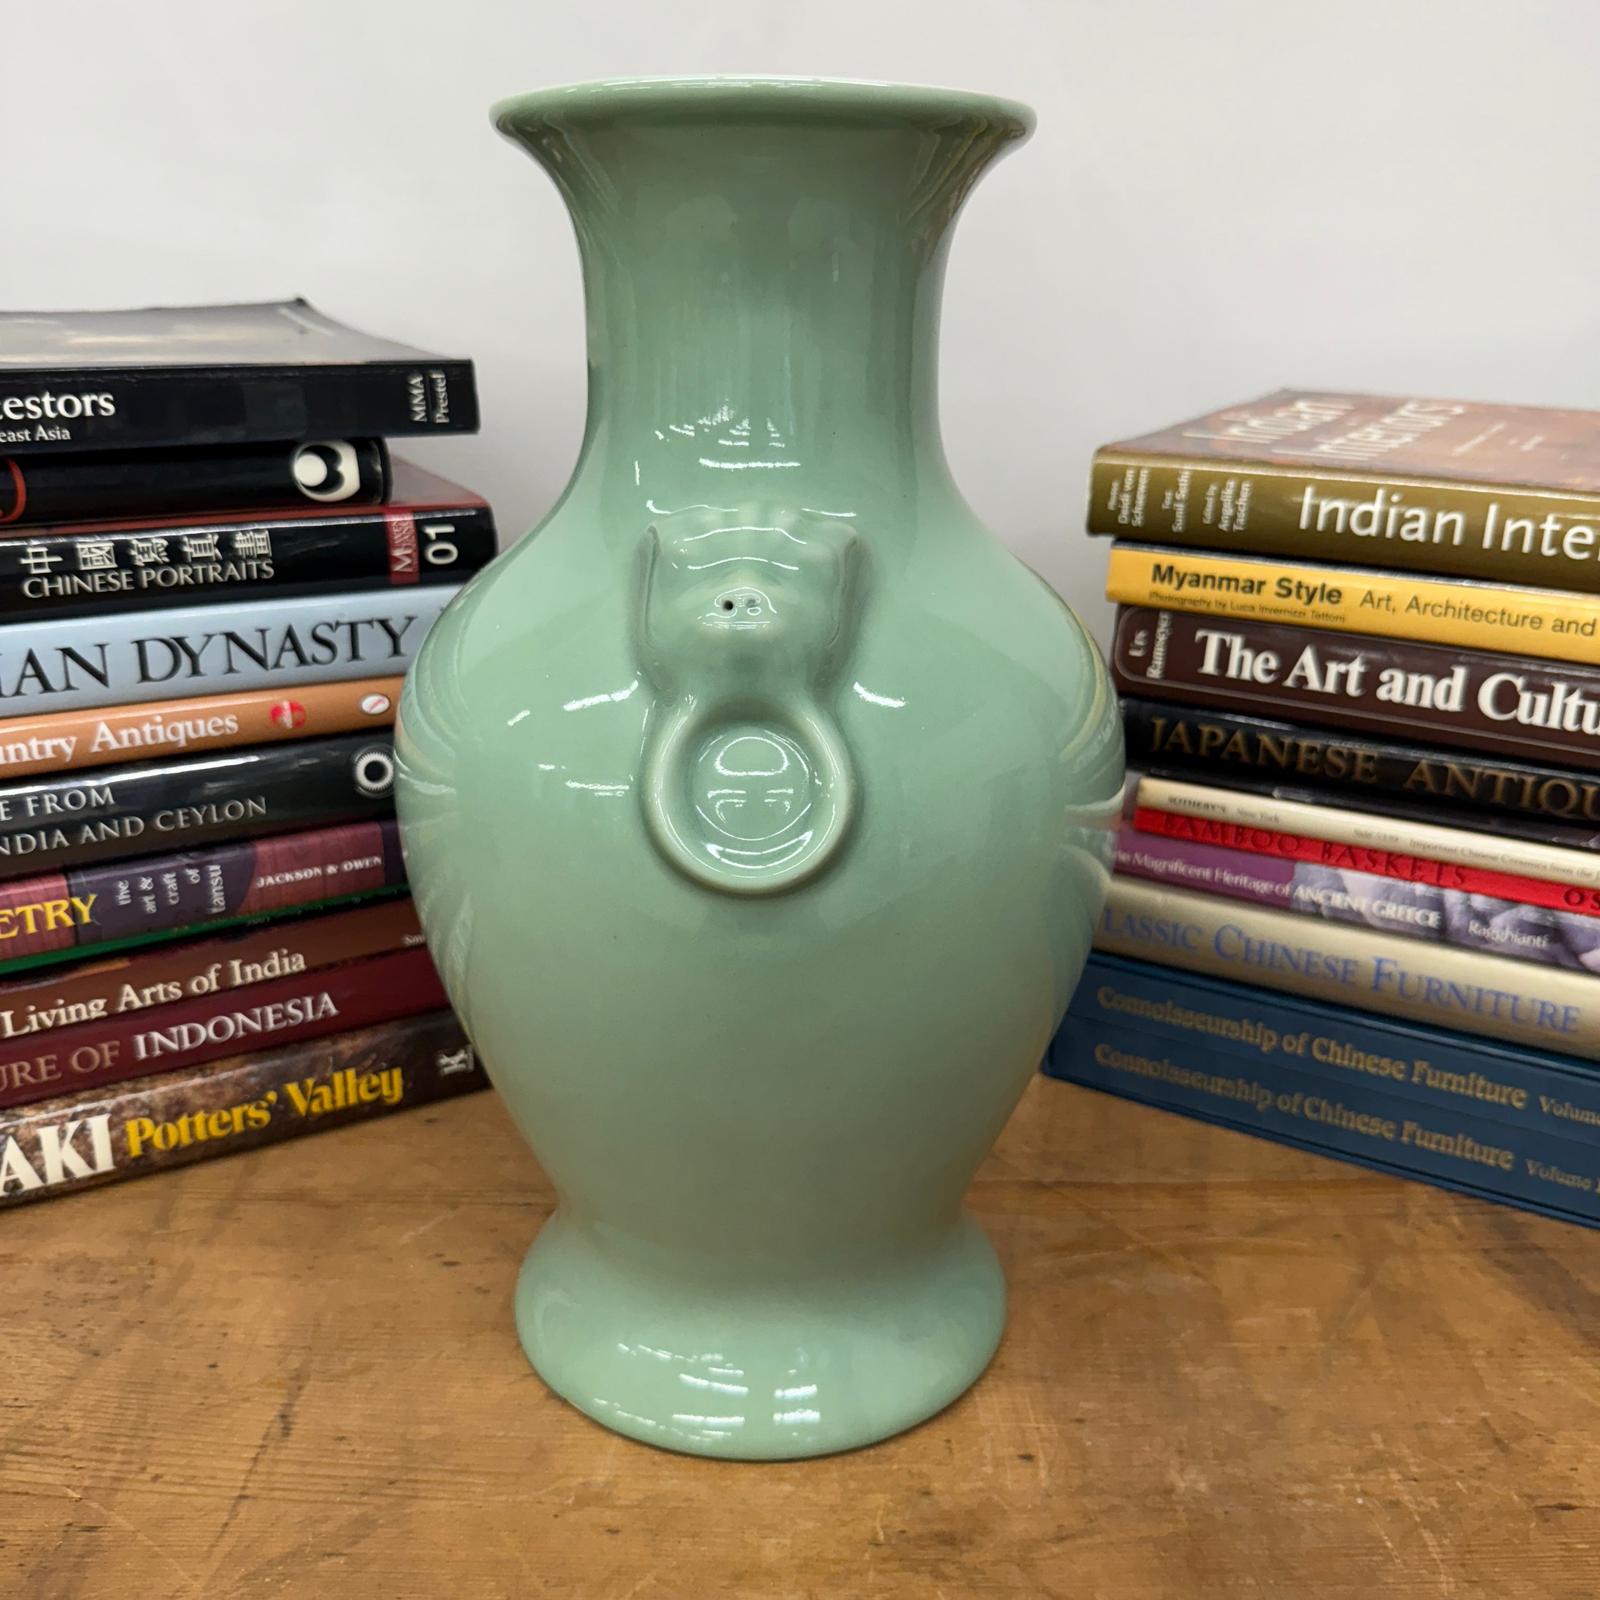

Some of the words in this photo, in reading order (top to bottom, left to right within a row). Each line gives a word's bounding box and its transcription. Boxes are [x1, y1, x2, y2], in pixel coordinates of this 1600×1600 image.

[0, 391, 116, 420] estors
[408, 372, 428, 422] MMA
[429, 369, 449, 424] Prestel
[35, 424, 71, 442] Asia
[1217, 479, 1236, 532] Angelika
[1233, 480, 1251, 532] Taschen
[1299, 484, 1465, 546] Indian
[1482, 502, 1600, 562] Inte
[424, 524, 458, 565] 01
[22, 569, 135, 598] CHINESE
[139, 558, 275, 589] PORTRAITS
[1151, 563, 1265, 596] Myanmar
[1275, 576, 1342, 607] Style
[1360, 589, 1396, 614] Art,
[1405, 594, 1543, 630] Architecture
[1551, 617, 1597, 637] and
[0, 642, 110, 698] AN
[131, 615, 418, 684] DYNASTY
[1194, 627, 1281, 684] The
[1282, 644, 1367, 695] Art
[1376, 664, 1469, 713] and
[91, 713, 239, 753] Antiques
[1151, 716, 1379, 783] JAPANESE
[26, 787, 116, 818] FROM
[80, 815, 145, 845] AND
[155, 796, 267, 832] CEYLON
[185, 867, 200, 885] of
[256, 866, 323, 889] JACKSON
[326, 863, 338, 876] &
[342, 855, 383, 874] OWEN
[1163, 814, 1301, 854] BAMBOO
[1320, 840, 1467, 885] BASKETS
[1132, 852, 1212, 882] Magnificent
[1214, 867, 1274, 895] Heritage
[1274, 881, 1292, 897] of
[1371, 900, 1441, 929] GREECE
[0, 998, 107, 1039] Living
[117, 980, 182, 1012] Arts
[190, 963, 221, 994] of
[227, 948, 307, 987] India
[1214, 922, 1359, 986] CHINESE
[1370, 955, 1582, 1035] FURNITURE
[70, 1040, 121, 1073] OF
[131, 991, 340, 1061] INDONESIA
[1281, 1031, 1310, 1057] of
[1311, 1036, 1407, 1081] Chinese
[1411, 1059, 1528, 1110] Furniture
[0, 1112, 117, 1197] AKI
[284, 1066, 404, 1118] Valley
[1276, 1092, 1304, 1115] of
[1302, 1096, 1397, 1141] Chinese
[1401, 1119, 1515, 1171] Furniture
[1526, 1157, 1592, 1191] Volume
